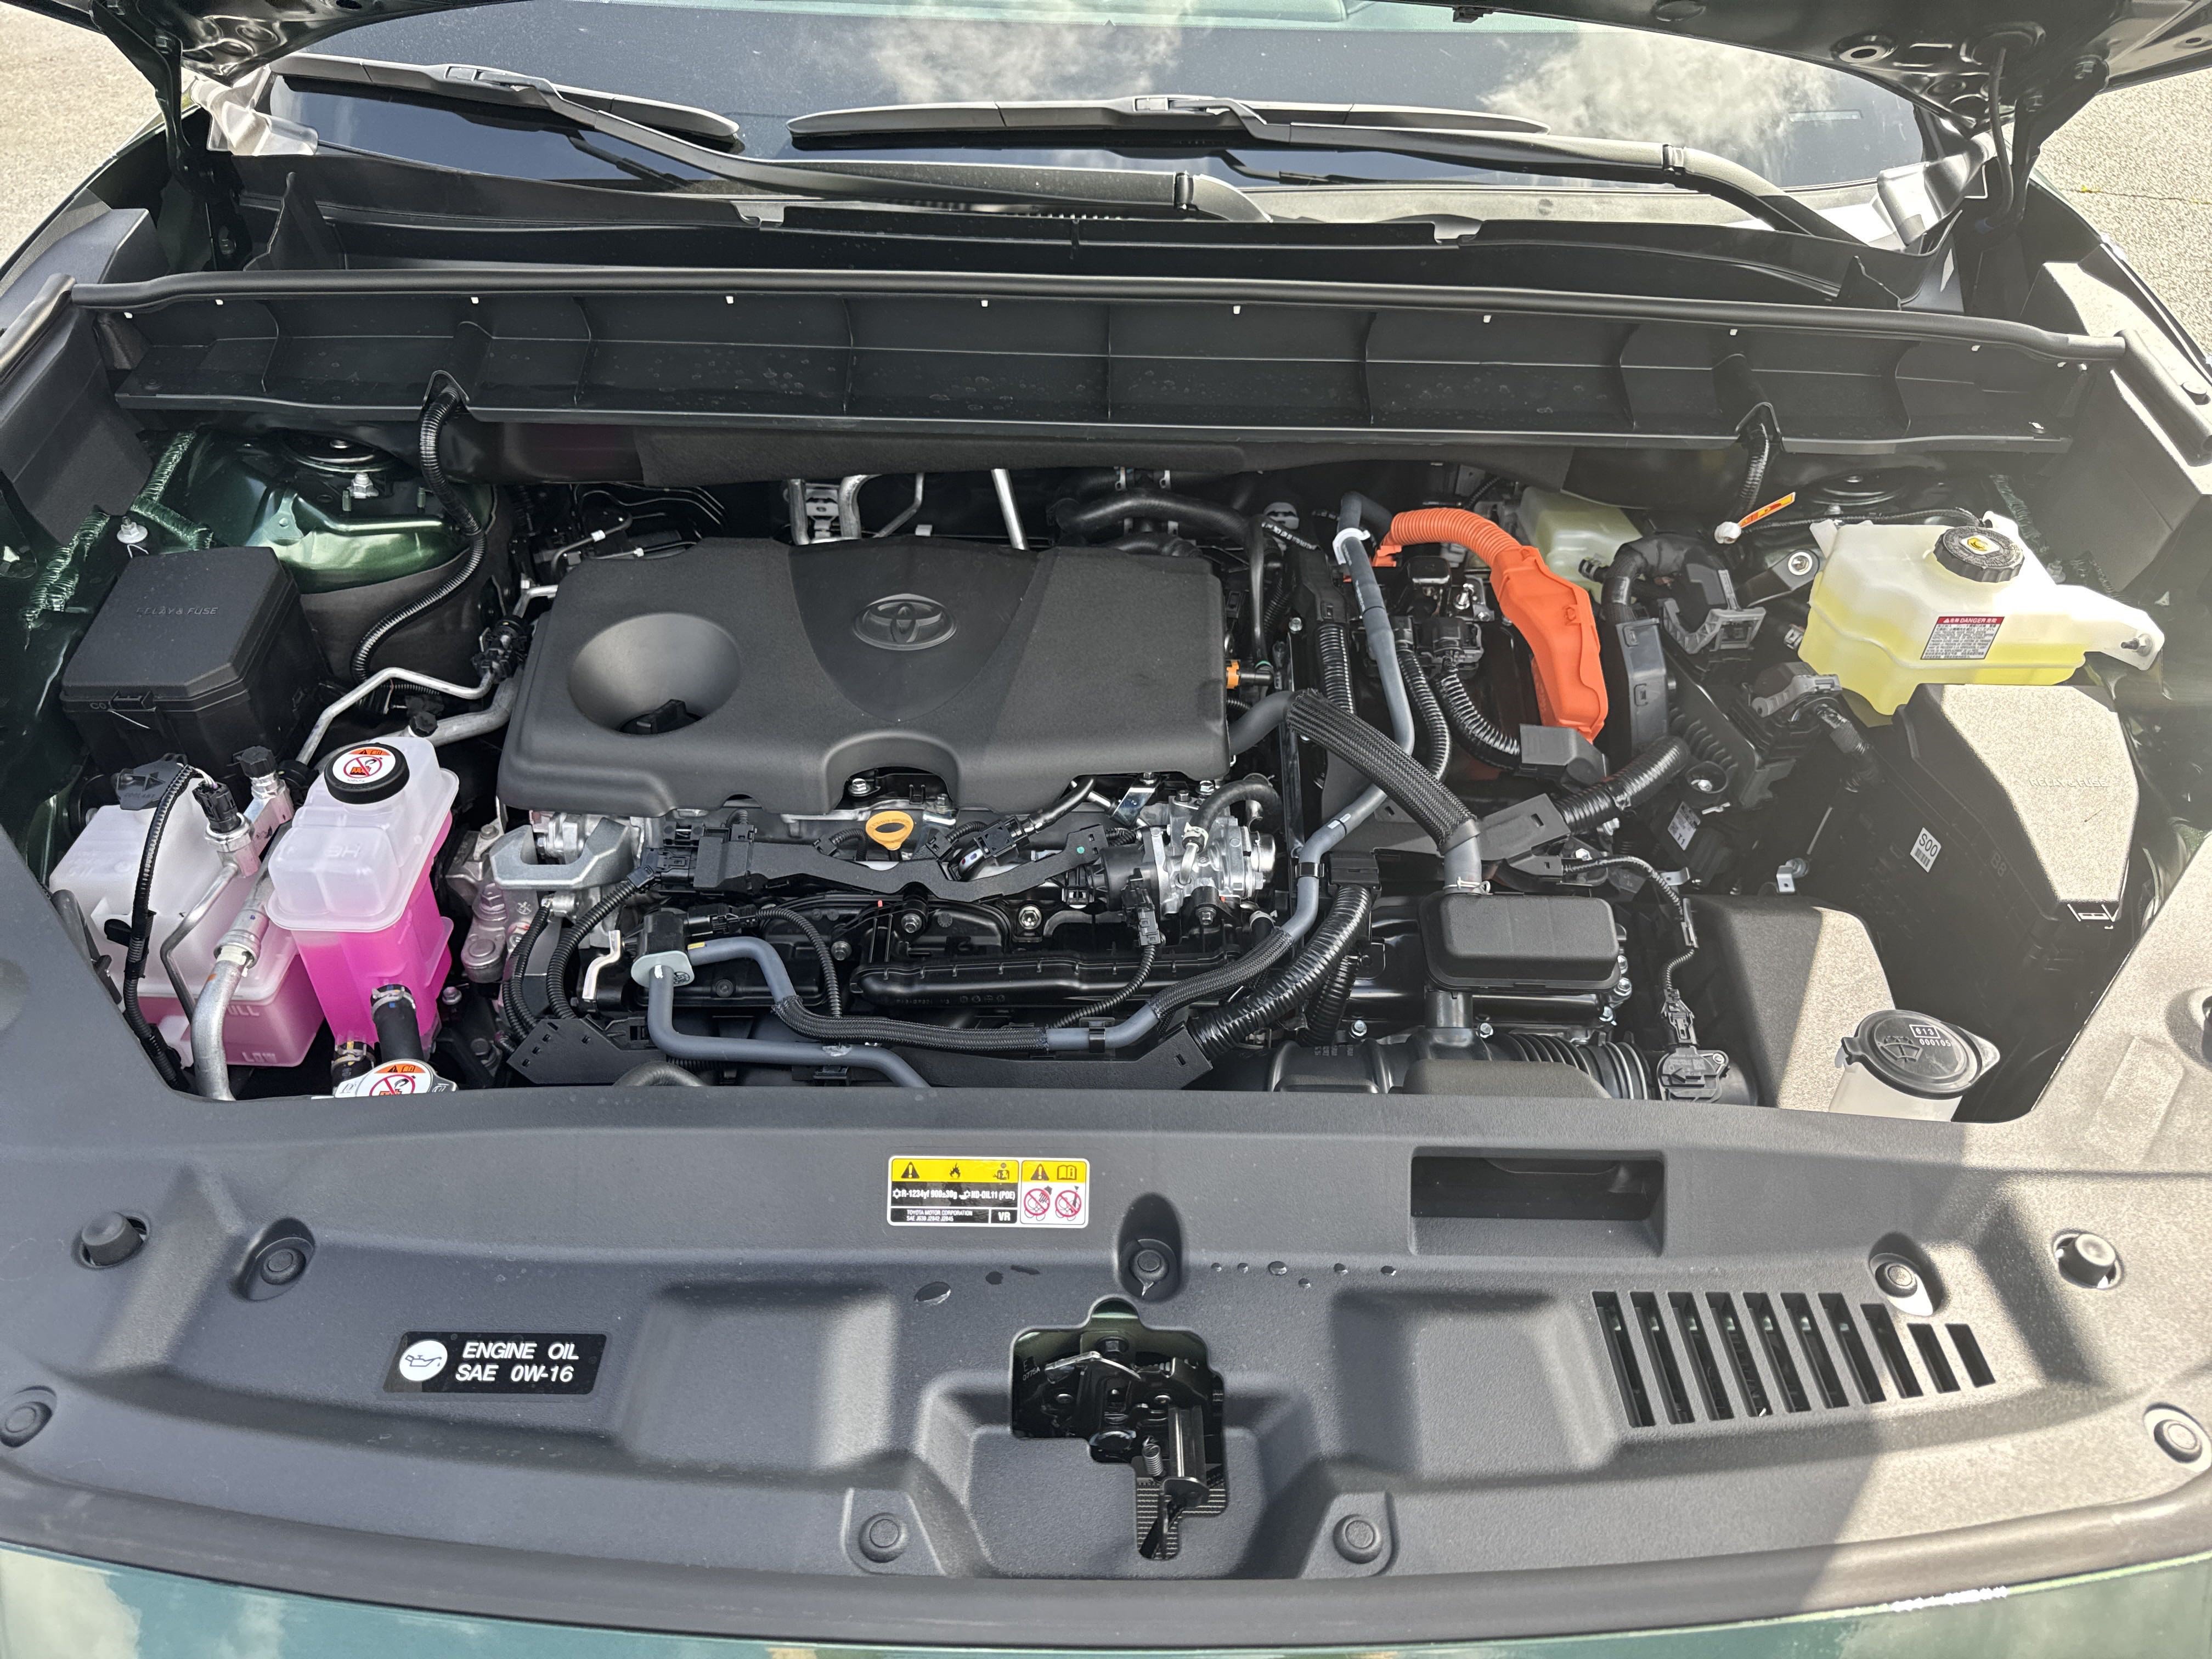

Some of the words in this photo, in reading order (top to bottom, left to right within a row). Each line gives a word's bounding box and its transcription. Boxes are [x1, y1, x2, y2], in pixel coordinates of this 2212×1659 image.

[187, 607, 219, 615] FUSE
[227, 1005, 259, 1017] ULL
[1919, 1038, 1952, 1047] 000105
[242, 1051, 278, 1064] LOW
[901, 1189, 930, 1199] R-1234yf
[998, 1190, 1015, 1200] (POE)
[998, 1211, 1011, 1221] VR
[462, 1342, 538, 1360] ENGINE
[548, 1343, 579, 1361] OIL
[455, 1364, 499, 1382] SAE
[510, 1365, 574, 1383] 0W-16
